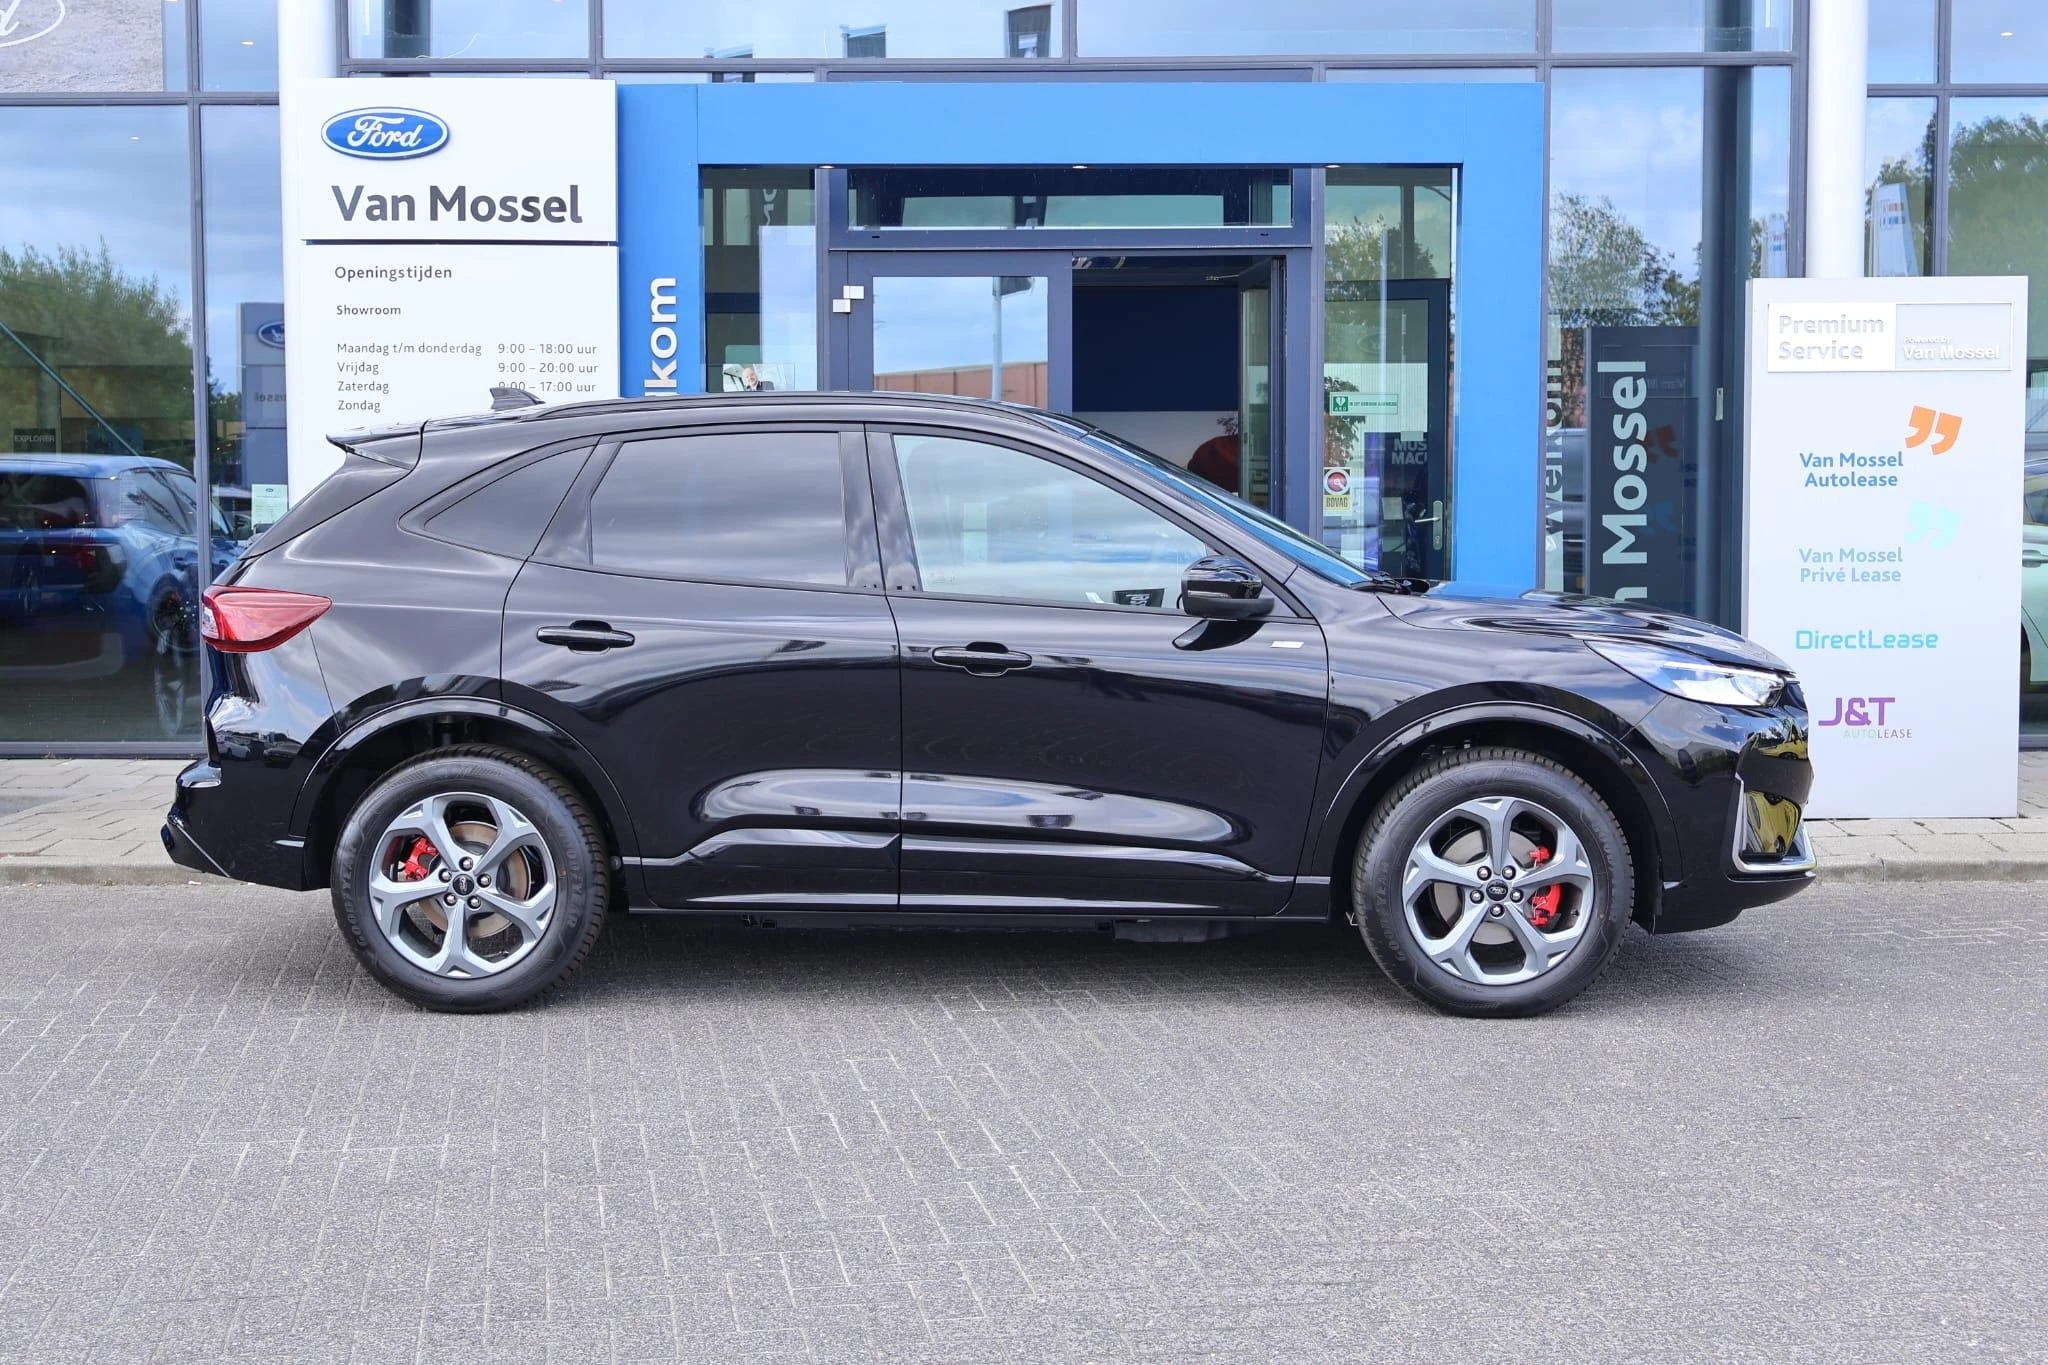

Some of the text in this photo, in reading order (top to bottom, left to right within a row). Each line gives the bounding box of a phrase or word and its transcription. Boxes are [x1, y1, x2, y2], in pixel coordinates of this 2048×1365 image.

[346, 114, 424, 149] Ford
[331, 185, 583, 224] Van Mossel
[334, 265, 453, 283] Openingstijden
[336, 304, 402, 316] Showroom
[1779, 314, 1885, 334] Premium
[337, 342, 389, 357] Maandag
[393, 343, 415, 354] t/m
[418, 342, 482, 357] donderdag
[498, 343, 525, 354] 9:00
[540, 343, 573, 354] 18:00
[577, 346, 598, 354] uur
[1779, 340, 1864, 360] Service
[1904, 344, 2000, 361] Van Mossel
[337, 361, 380, 376] Vrijdag
[498, 362, 525, 373] 9:00
[539, 362, 575, 373] 20:00
[578, 365, 599, 373] uur
[338, 380, 390, 395] Zaterdag
[540, 381, 573, 392] 17:00
[576, 384, 597, 392] uur
[338, 400, 381, 413] Zondag
[1391, 452, 1428, 465] MAC
[1597, 361, 1648, 564] Mossel
[1799, 451, 1904, 468] Van Mossel
[1804, 471, 1898, 488] Autolease
[1325, 496, 1349, 508] BOVAG
[1799, 546, 1903, 563] Van Mossel
[1800, 566, 1902, 582] Privé Lease
[1795, 629, 1939, 650] DirectLease
[1818, 697, 1896, 727] J&T
[1843, 728, 1913, 739] AUTOLEASE
